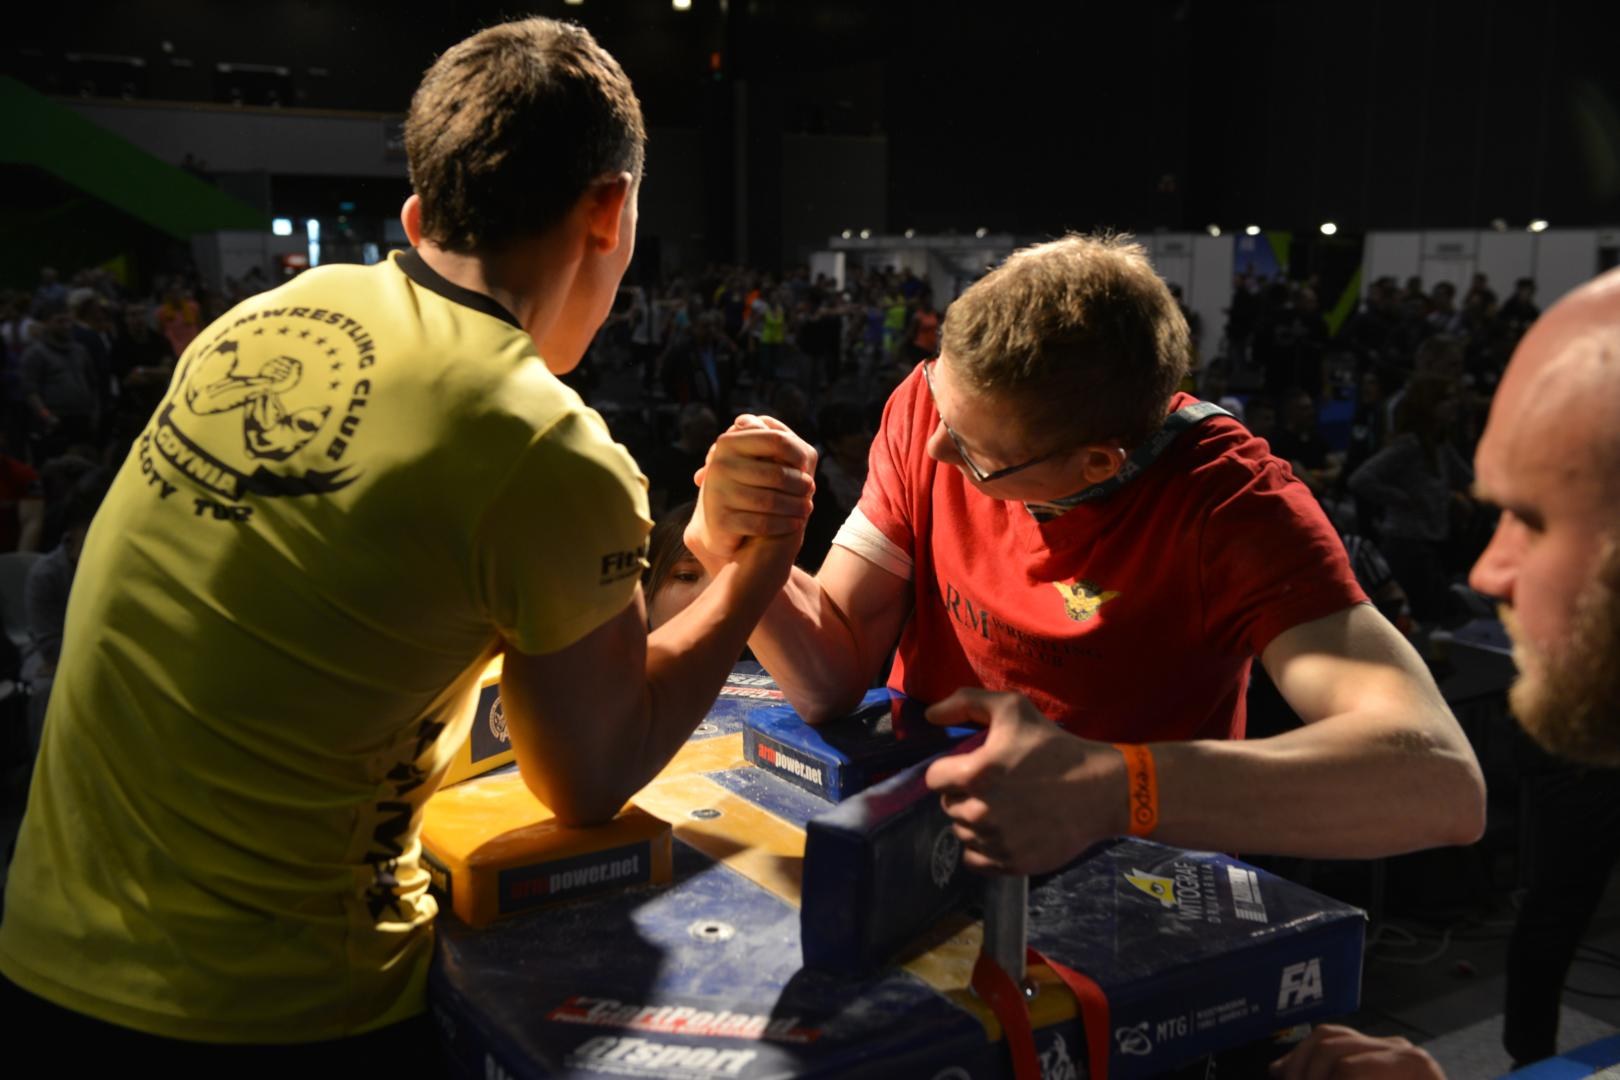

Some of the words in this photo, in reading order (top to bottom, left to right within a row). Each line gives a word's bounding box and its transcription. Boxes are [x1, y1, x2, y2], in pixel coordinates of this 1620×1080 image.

[326, 379, 370, 461] CLUB
[945, 582, 994, 643] RM
[757, 742, 823, 786] armpower.net
[511, 853, 640, 898] armpower.net
[1173, 860, 1203, 921] WITOGRAF
[1276, 957, 1324, 1012] FA
[1156, 1015, 1188, 1042] MTG
